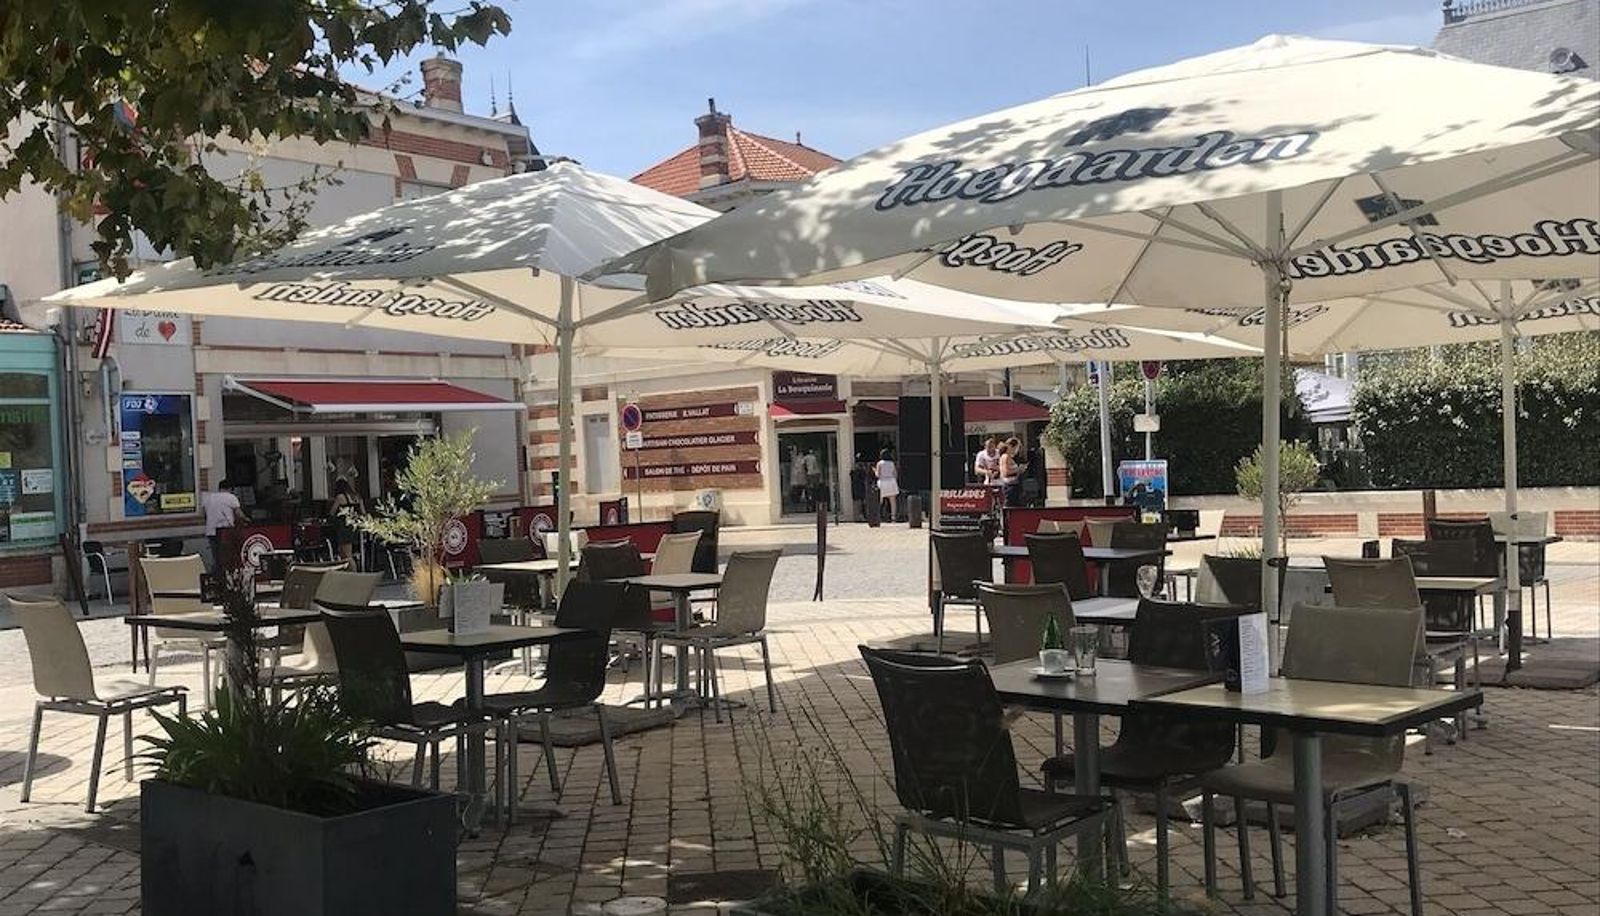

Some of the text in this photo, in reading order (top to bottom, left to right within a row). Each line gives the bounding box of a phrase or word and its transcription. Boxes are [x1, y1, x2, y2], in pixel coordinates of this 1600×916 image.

[875, 130, 1319, 210] Hoegaarden
[135, 322, 151, 338] de
[125, 399, 143, 409] FDJ
[668, 436, 708, 447] CHOCOLATIER
[708, 434, 736, 444] GLACIER
[644, 467, 665, 476] SALON
[712, 465, 720, 473] DE
[721, 463, 737, 473] PAIN
[940, 489, 986, 499] RILLADES
